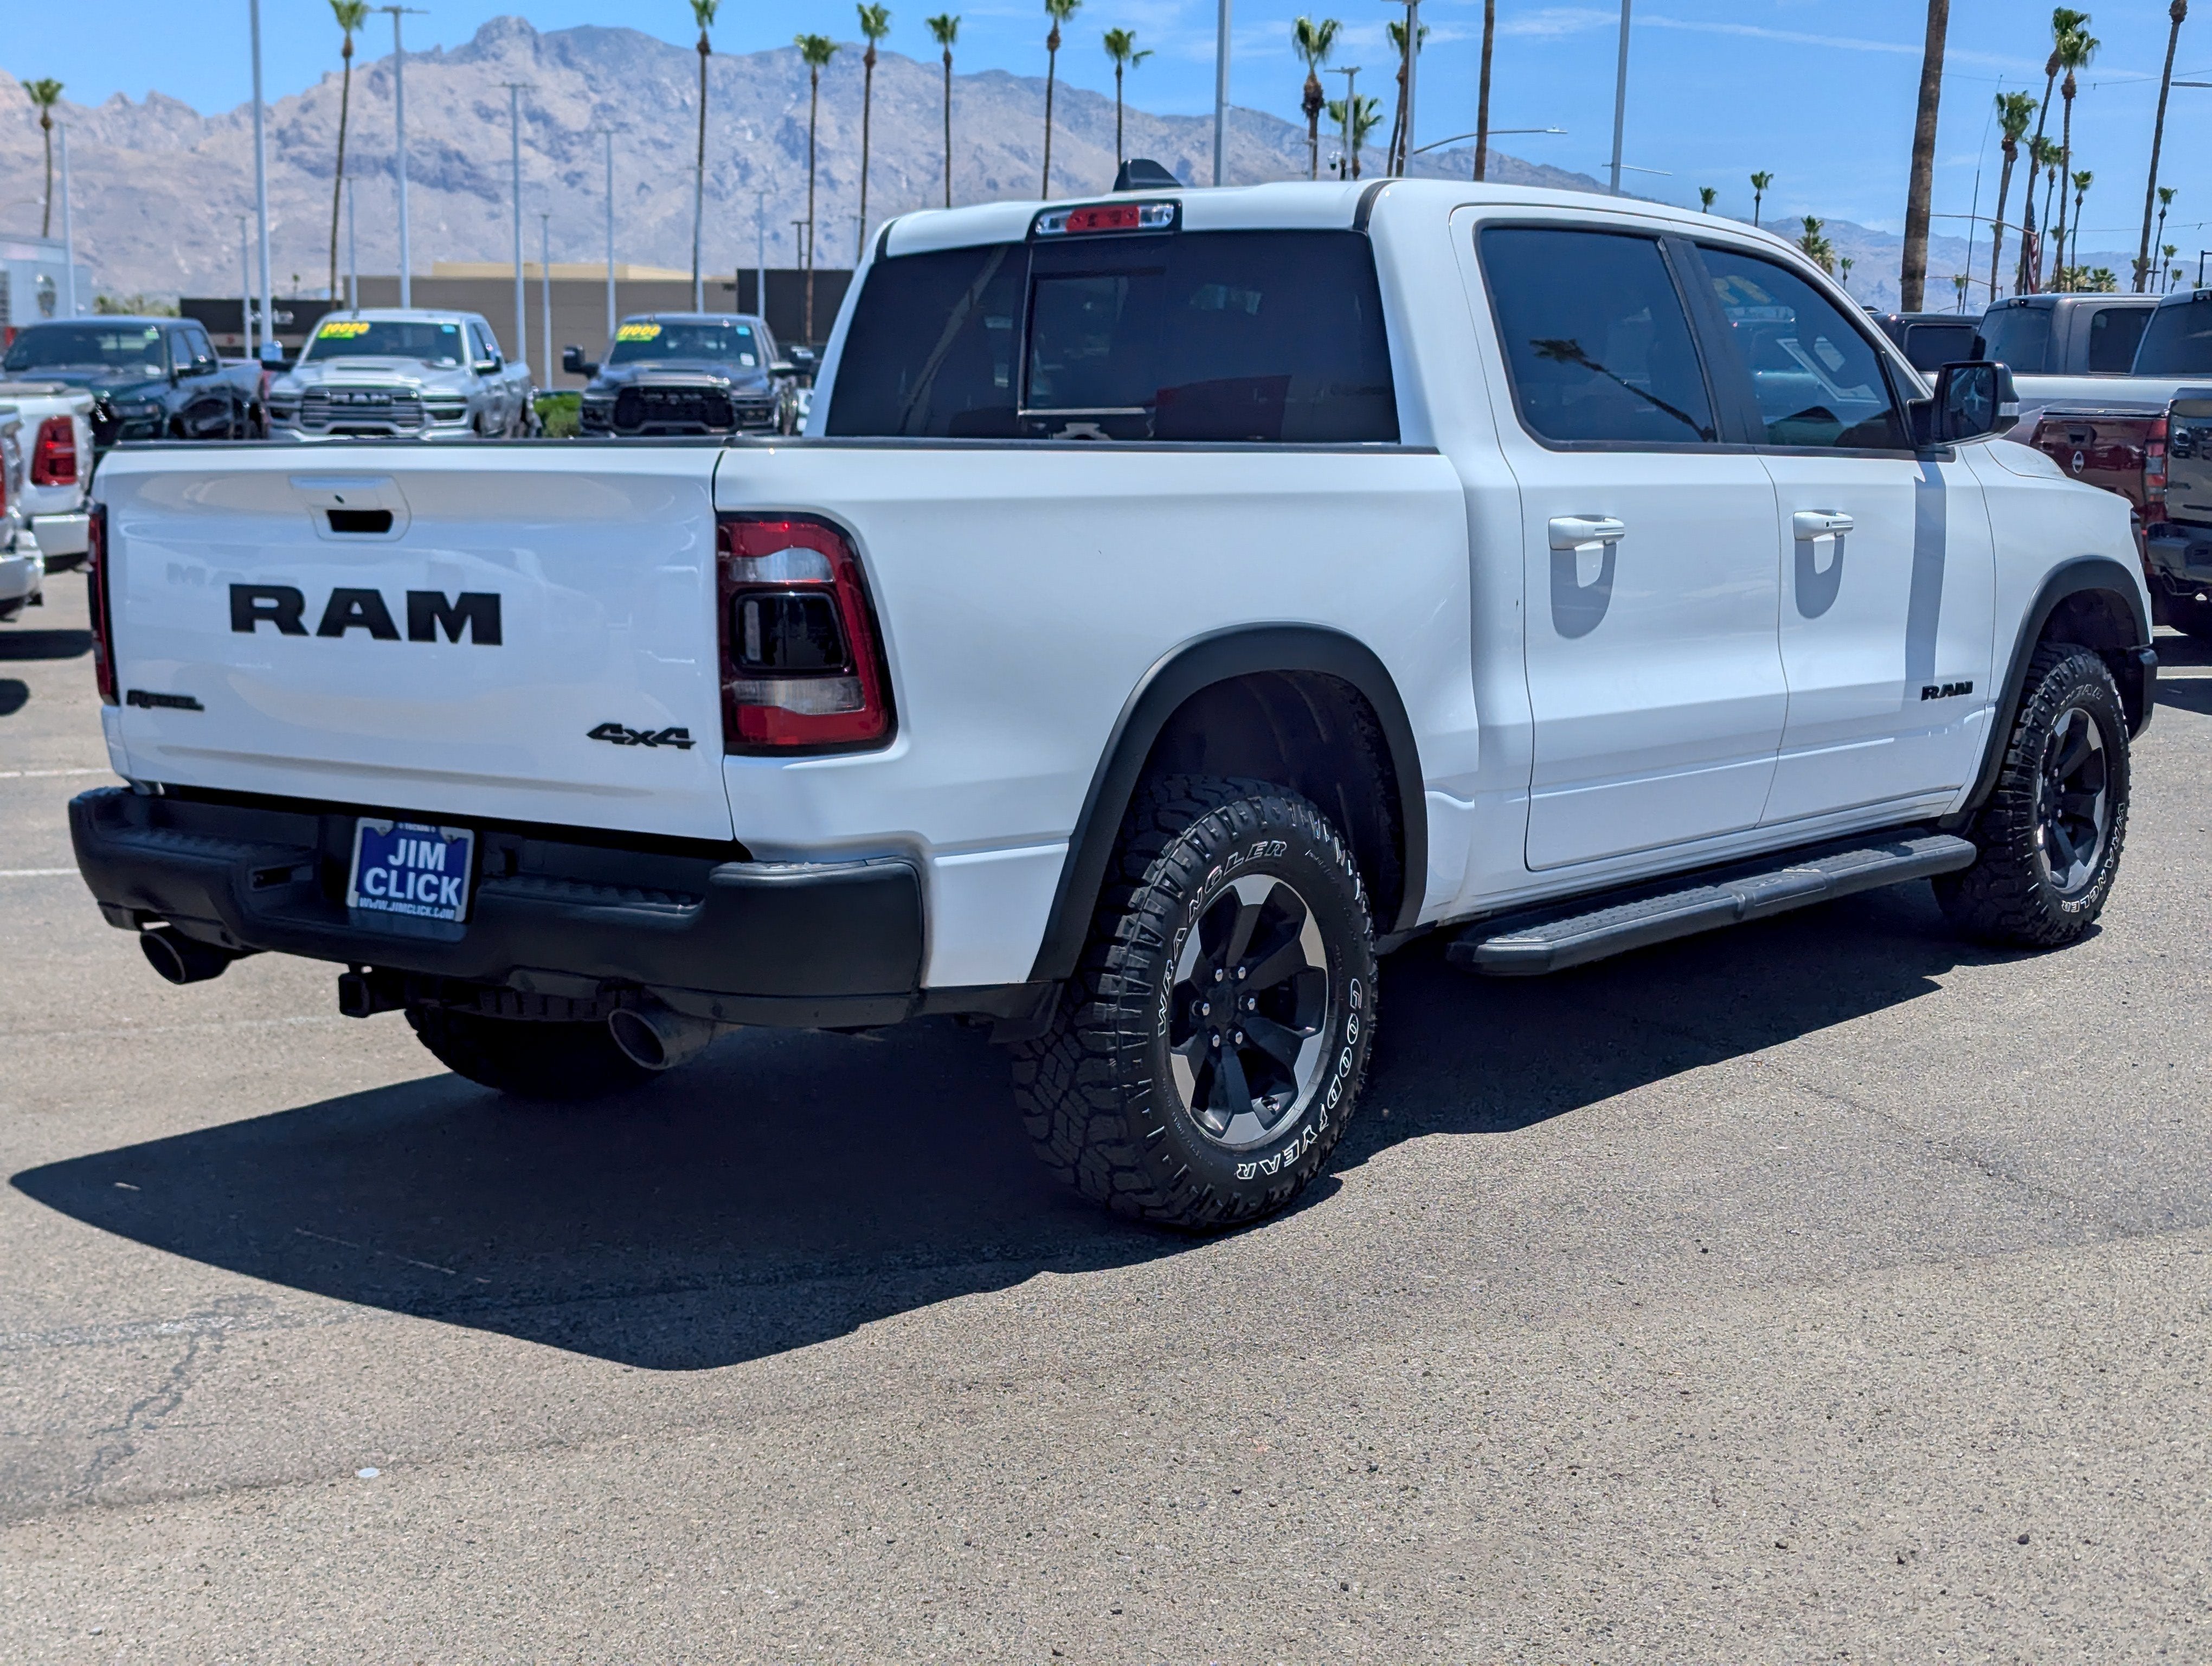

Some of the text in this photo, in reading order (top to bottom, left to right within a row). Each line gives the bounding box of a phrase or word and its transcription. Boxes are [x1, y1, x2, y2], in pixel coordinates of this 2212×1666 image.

[229, 583, 504, 646] RAM
[1920, 680, 1973, 701] RAM
[586, 722, 697, 750] 4x4
[387, 837, 447, 872] JIM
[364, 867, 462, 907] CLICK
[1158, 840, 1288, 1037] WRANGLER
[1236, 978, 1363, 1180] GOODYEAR
